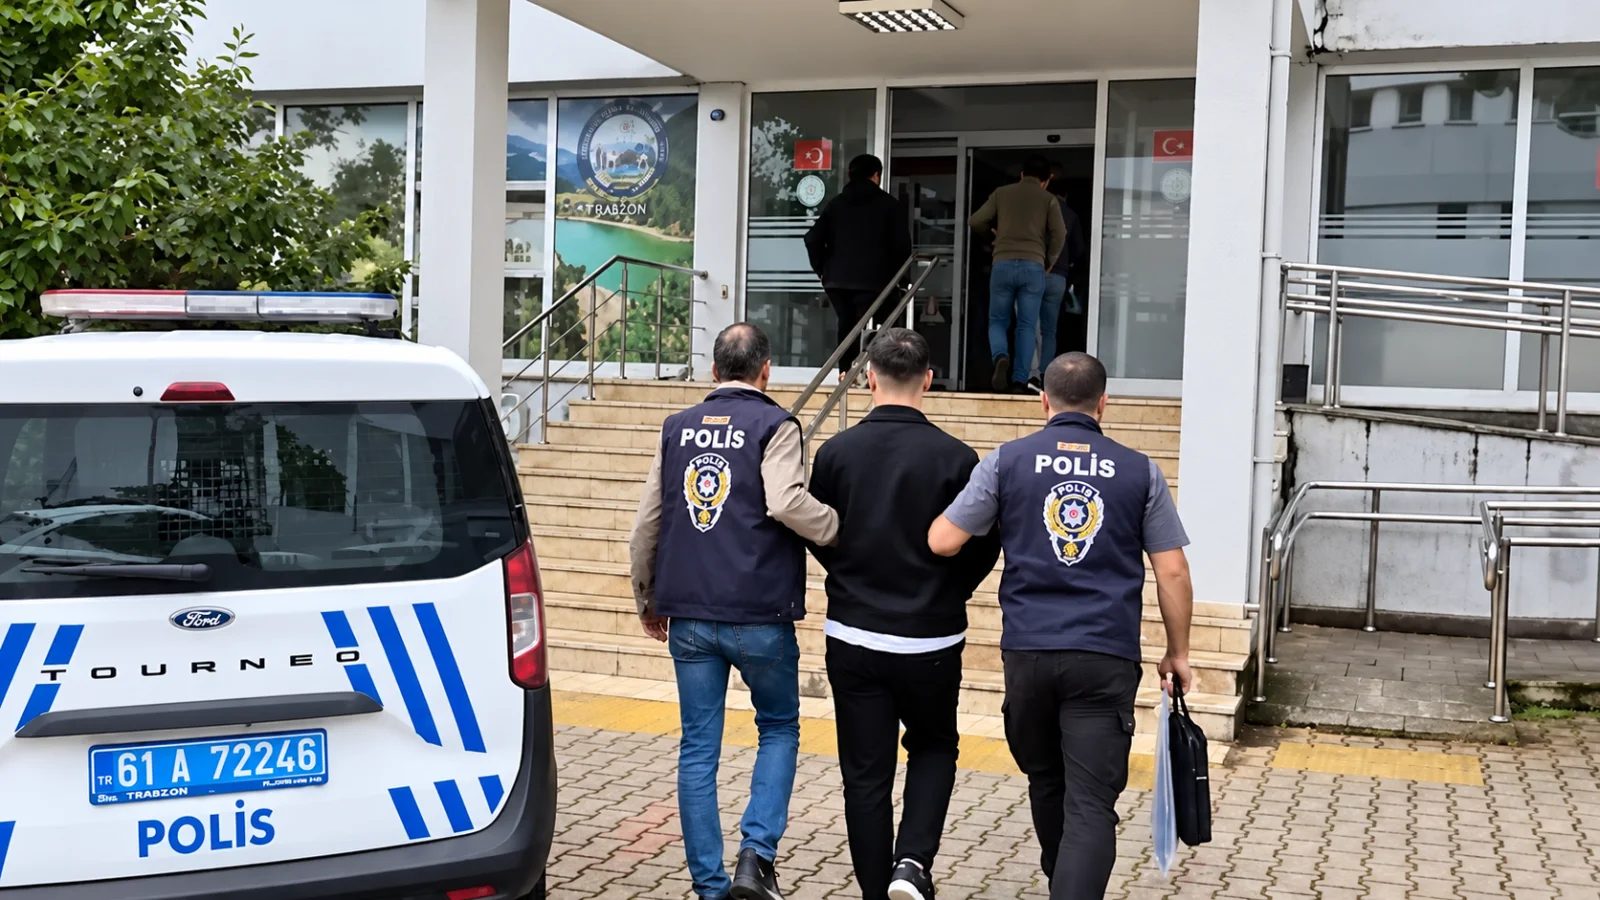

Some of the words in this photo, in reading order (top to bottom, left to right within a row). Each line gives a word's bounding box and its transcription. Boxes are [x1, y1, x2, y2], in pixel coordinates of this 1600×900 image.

[680, 425, 746, 449] POLİS
[1035, 453, 1116, 478] POLİS
[182, 611, 222, 628] Ford
[40, 650, 360, 682] TOURNEO
[97, 775, 113, 786] TR
[117, 751, 154, 788] 61
[171, 749, 191, 783] A
[210, 737, 317, 780] 72246
[126, 787, 189, 800] TRABZON
[137, 799, 276, 858] POLİS
